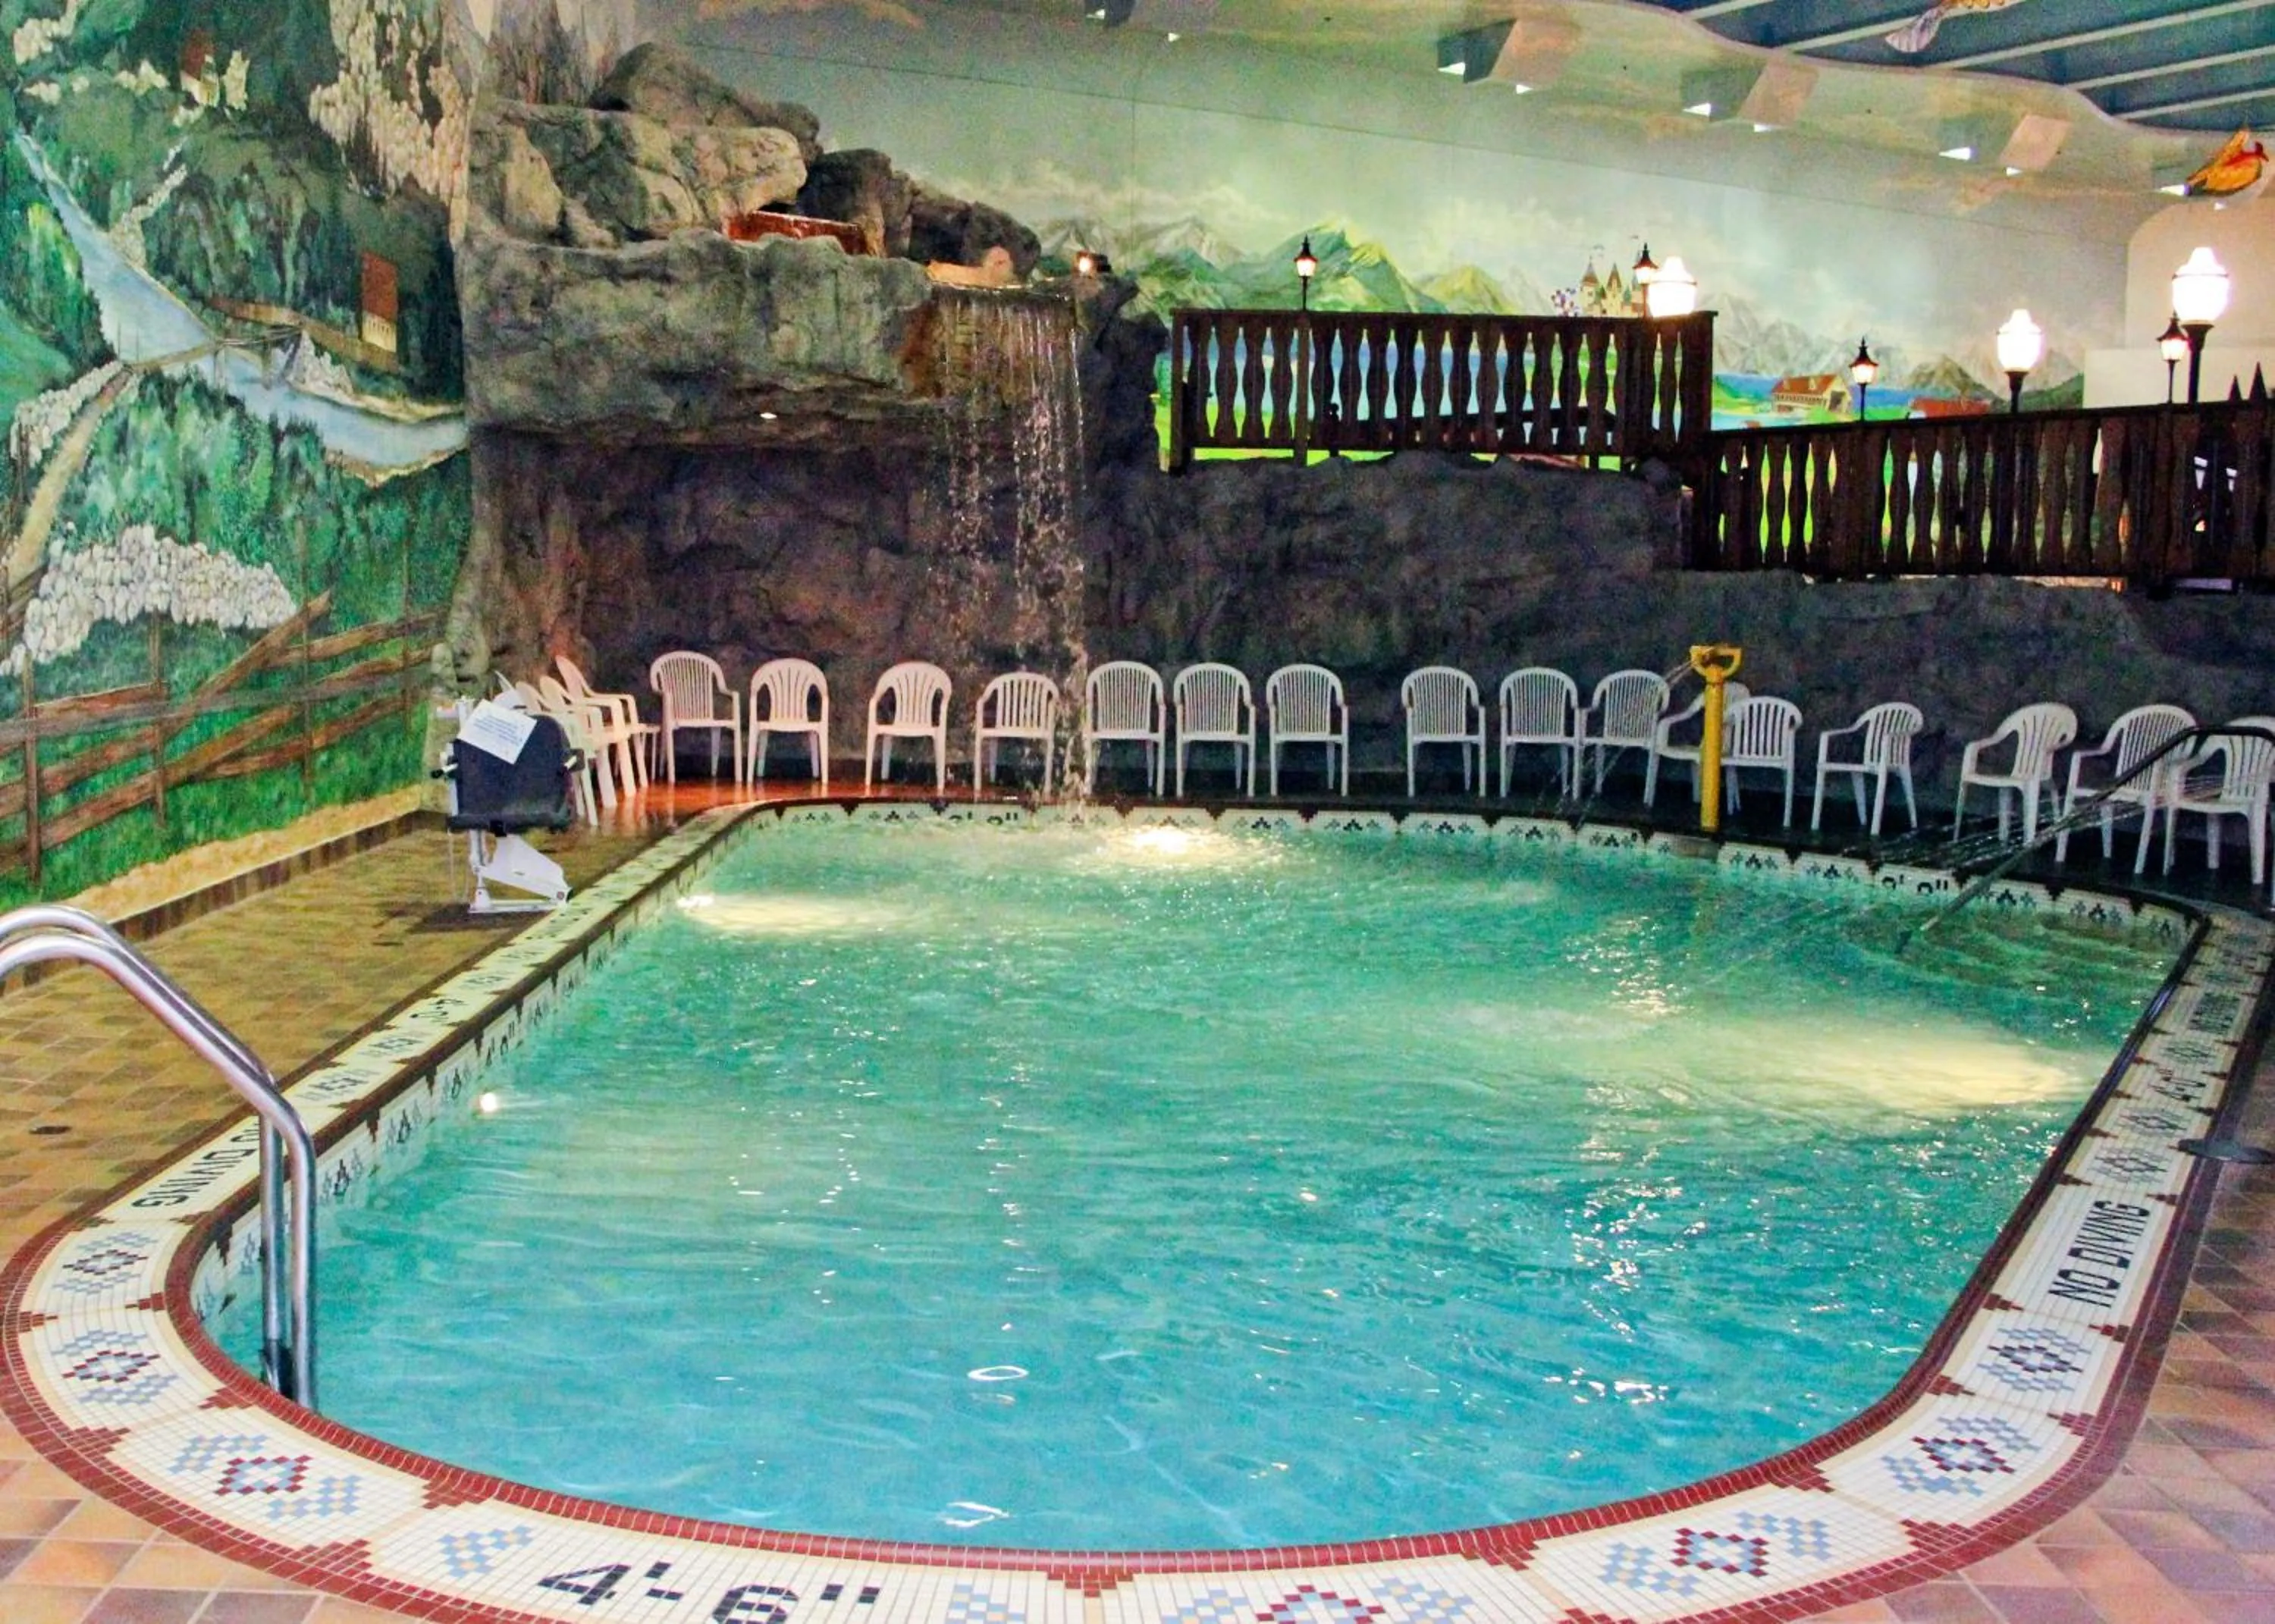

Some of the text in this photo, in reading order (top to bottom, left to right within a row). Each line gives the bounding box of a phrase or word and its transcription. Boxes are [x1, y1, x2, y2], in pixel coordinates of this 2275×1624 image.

[131, 1149, 257, 1207] DIVING
[2048, 1200, 2150, 1308] NO DIVING
